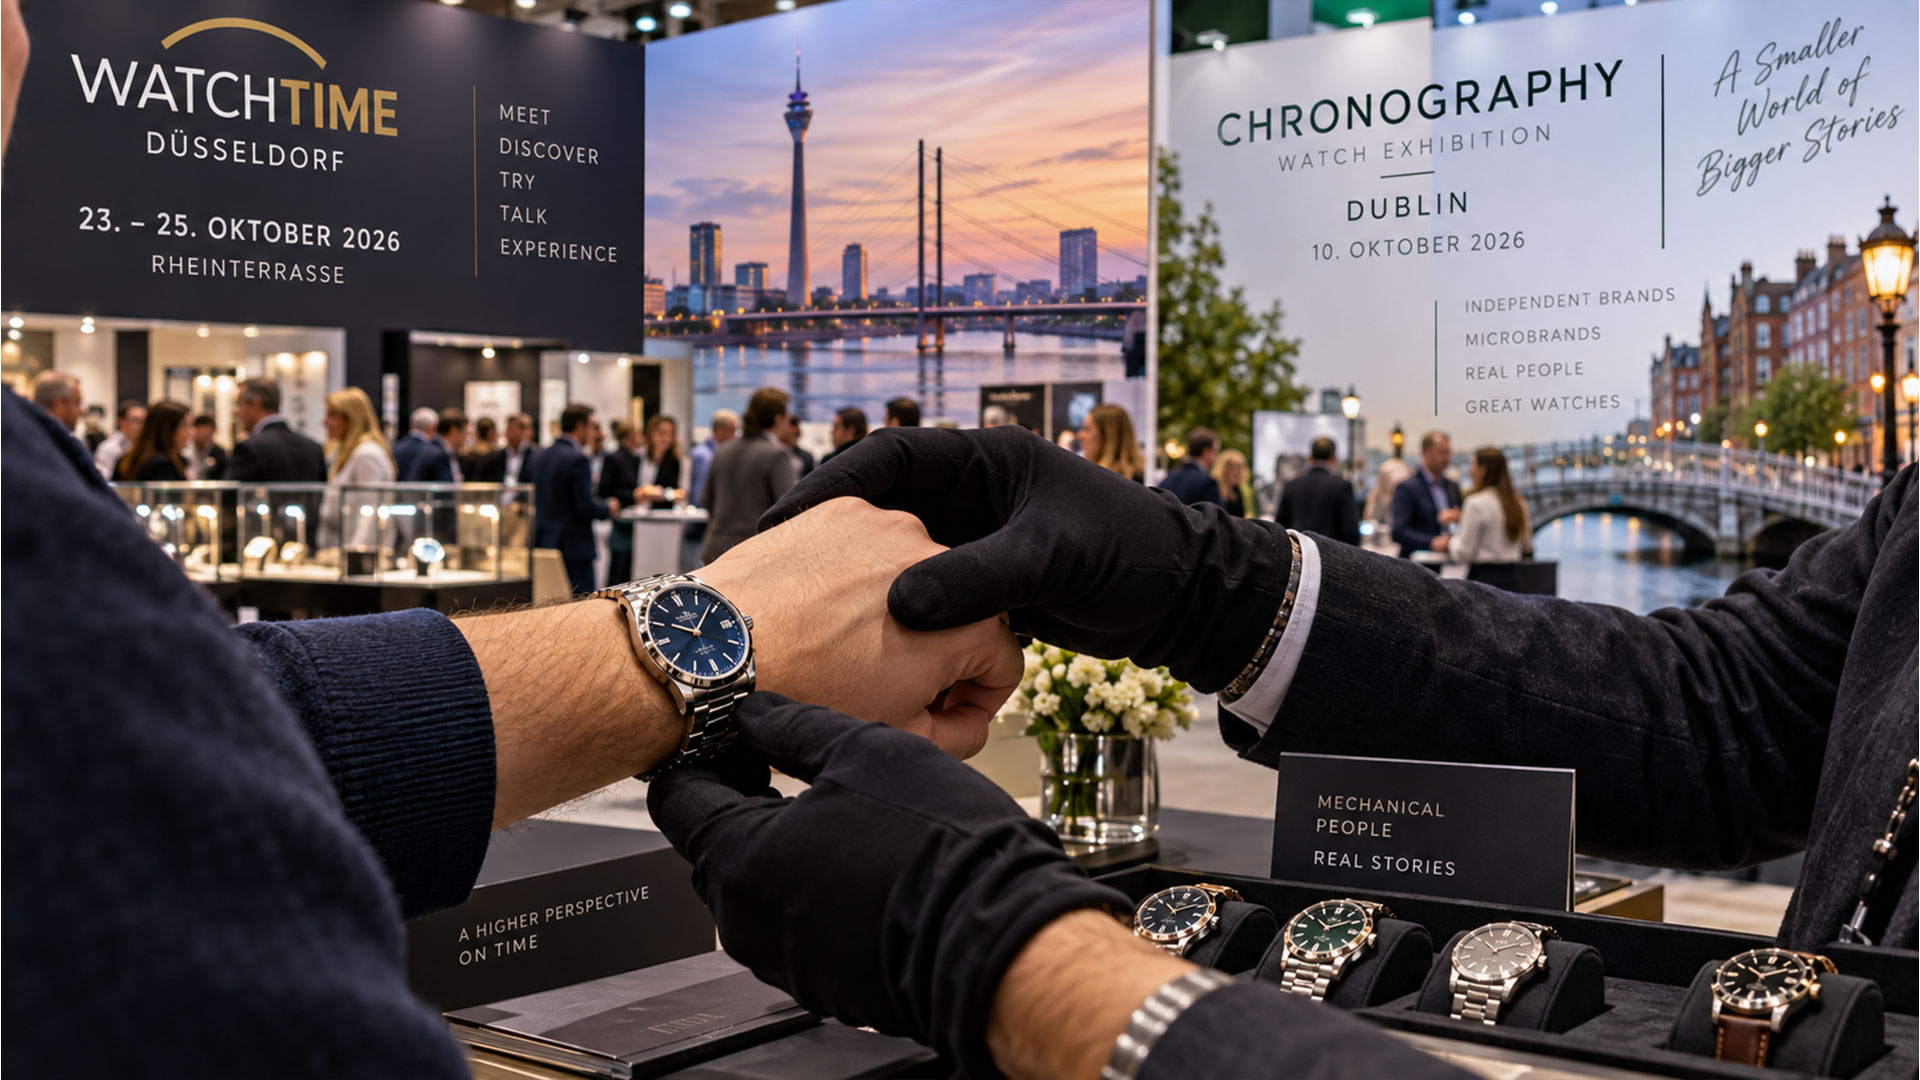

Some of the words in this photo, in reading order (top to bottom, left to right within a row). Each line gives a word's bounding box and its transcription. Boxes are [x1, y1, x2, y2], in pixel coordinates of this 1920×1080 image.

[1714, 50, 1743, 98] A
[1754, 17, 1865, 86] Smaller
[71, 53, 398, 137] WATCHTIME
[1217, 59, 1624, 147] CHRONOGRAPHY
[1737, 66, 1830, 136] World
[1838, 56, 1872, 108] of
[500, 104, 551, 126] MEET
[148, 129, 344, 172] DÜSSELDORF
[500, 138, 599, 165] DISCOVER
[1278, 146, 1366, 172] WATCH
[1384, 124, 1550, 160] EXHIBITION
[1696, 142, 1792, 198] Bigger
[1803, 105, 1905, 164] Stories
[500, 171, 536, 191] TRY
[500, 205, 548, 225] TALK
[1348, 192, 1467, 222] DUBLIN
[80, 206, 121, 233] 23.
[157, 213, 197, 238] 25.
[209, 217, 331, 247] OKTOBER
[343, 227, 400, 252] 2026
[501, 239, 618, 263] EXPERIENCE
[1313, 243, 1340, 261] 10.
[1350, 235, 1460, 259] OKTOBER
[1471, 231, 1525, 252] 2026
[153, 255, 344, 284] RHEINTERRASSE
[1466, 292, 1592, 314] INDEPENDENT
[1600, 287, 1676, 306] BRANDS
[1466, 326, 1602, 347] MICROBRANDS
[1466, 366, 1509, 381] REAL
[1517, 362, 1584, 378] PEOPLE
[1466, 398, 1523, 415] GREAT
[1531, 394, 1621, 412] WATCHES
[1318, 795, 1445, 818] MECHANICAL
[1317, 818, 1392, 838] PEOPLE
[1314, 851, 1363, 869] REAL
[1372, 855, 1456, 877] STORIES
[459, 928, 470, 943] A
[476, 912, 539, 939] HIGHER
[546, 886, 649, 923] PERSPECTIVE
[459, 947, 487, 966] ON
[495, 934, 538, 957] TIME
